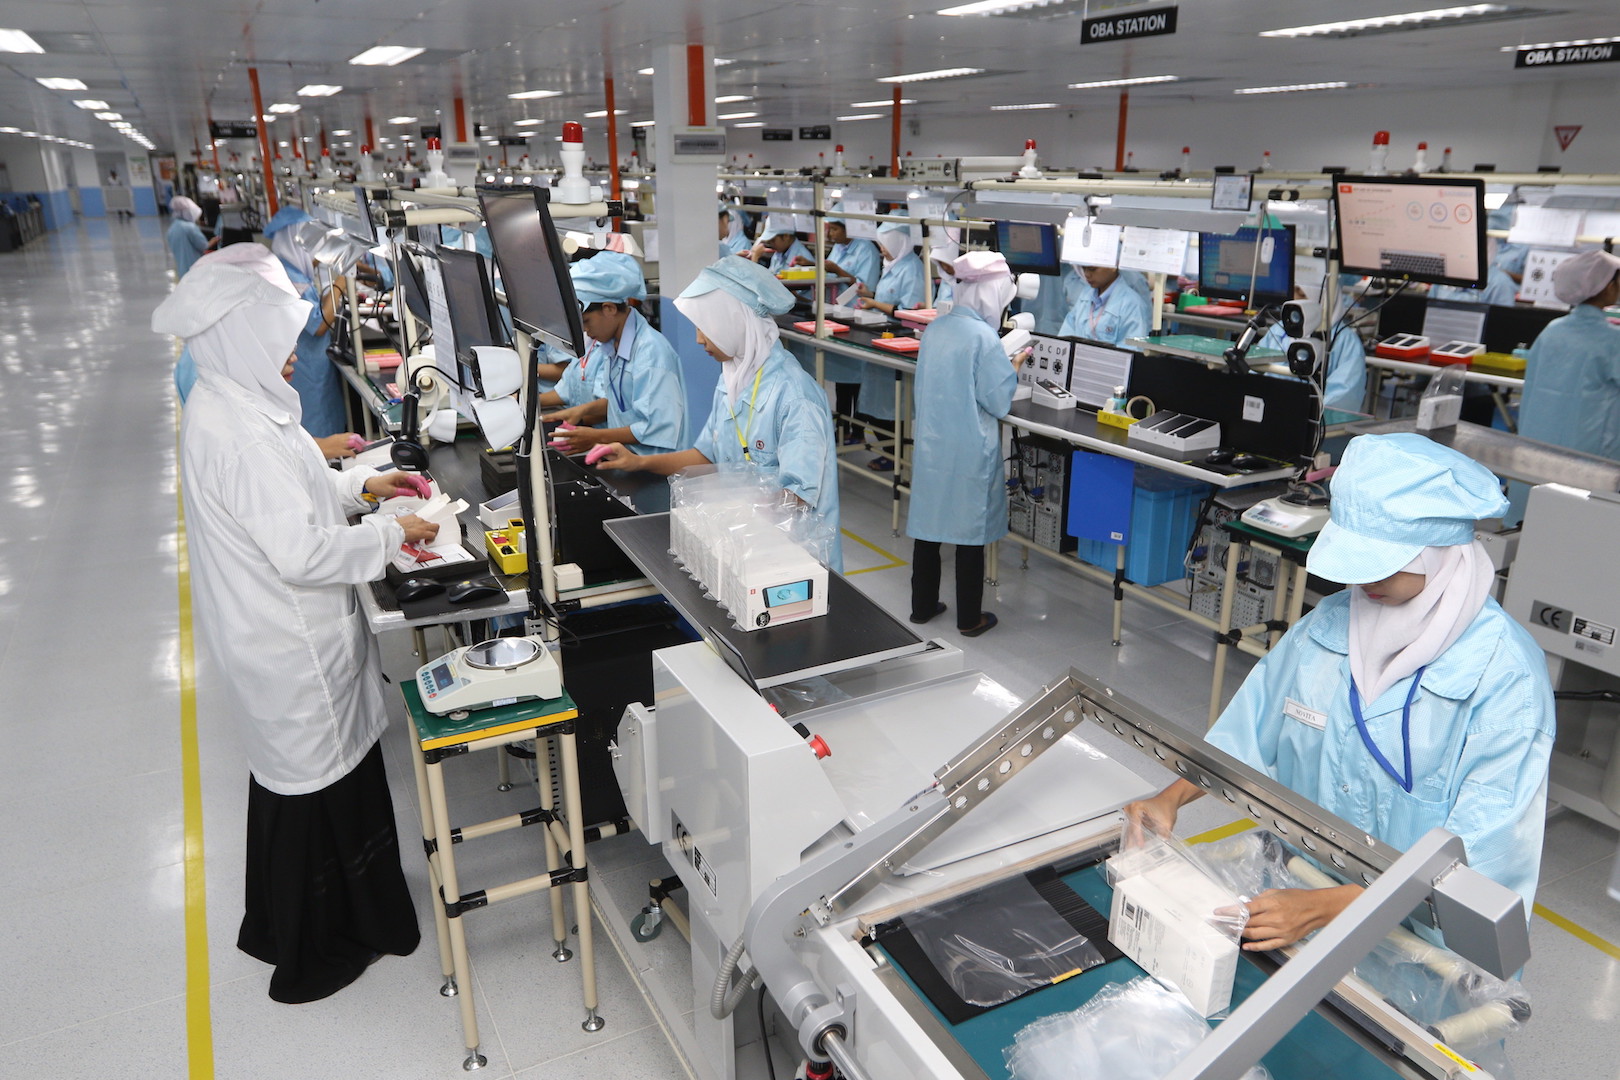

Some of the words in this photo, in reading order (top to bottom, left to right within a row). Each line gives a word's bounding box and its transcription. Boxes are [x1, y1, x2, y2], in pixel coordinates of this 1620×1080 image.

[1090, 21, 1115, 38] OBA
[1116, 13, 1167, 36] STATION
[1525, 49, 1554, 65] OBA
[1555, 45, 1613, 62] STATION
[1540, 607, 1563, 629] CE
[676, 823, 688, 856] CE
